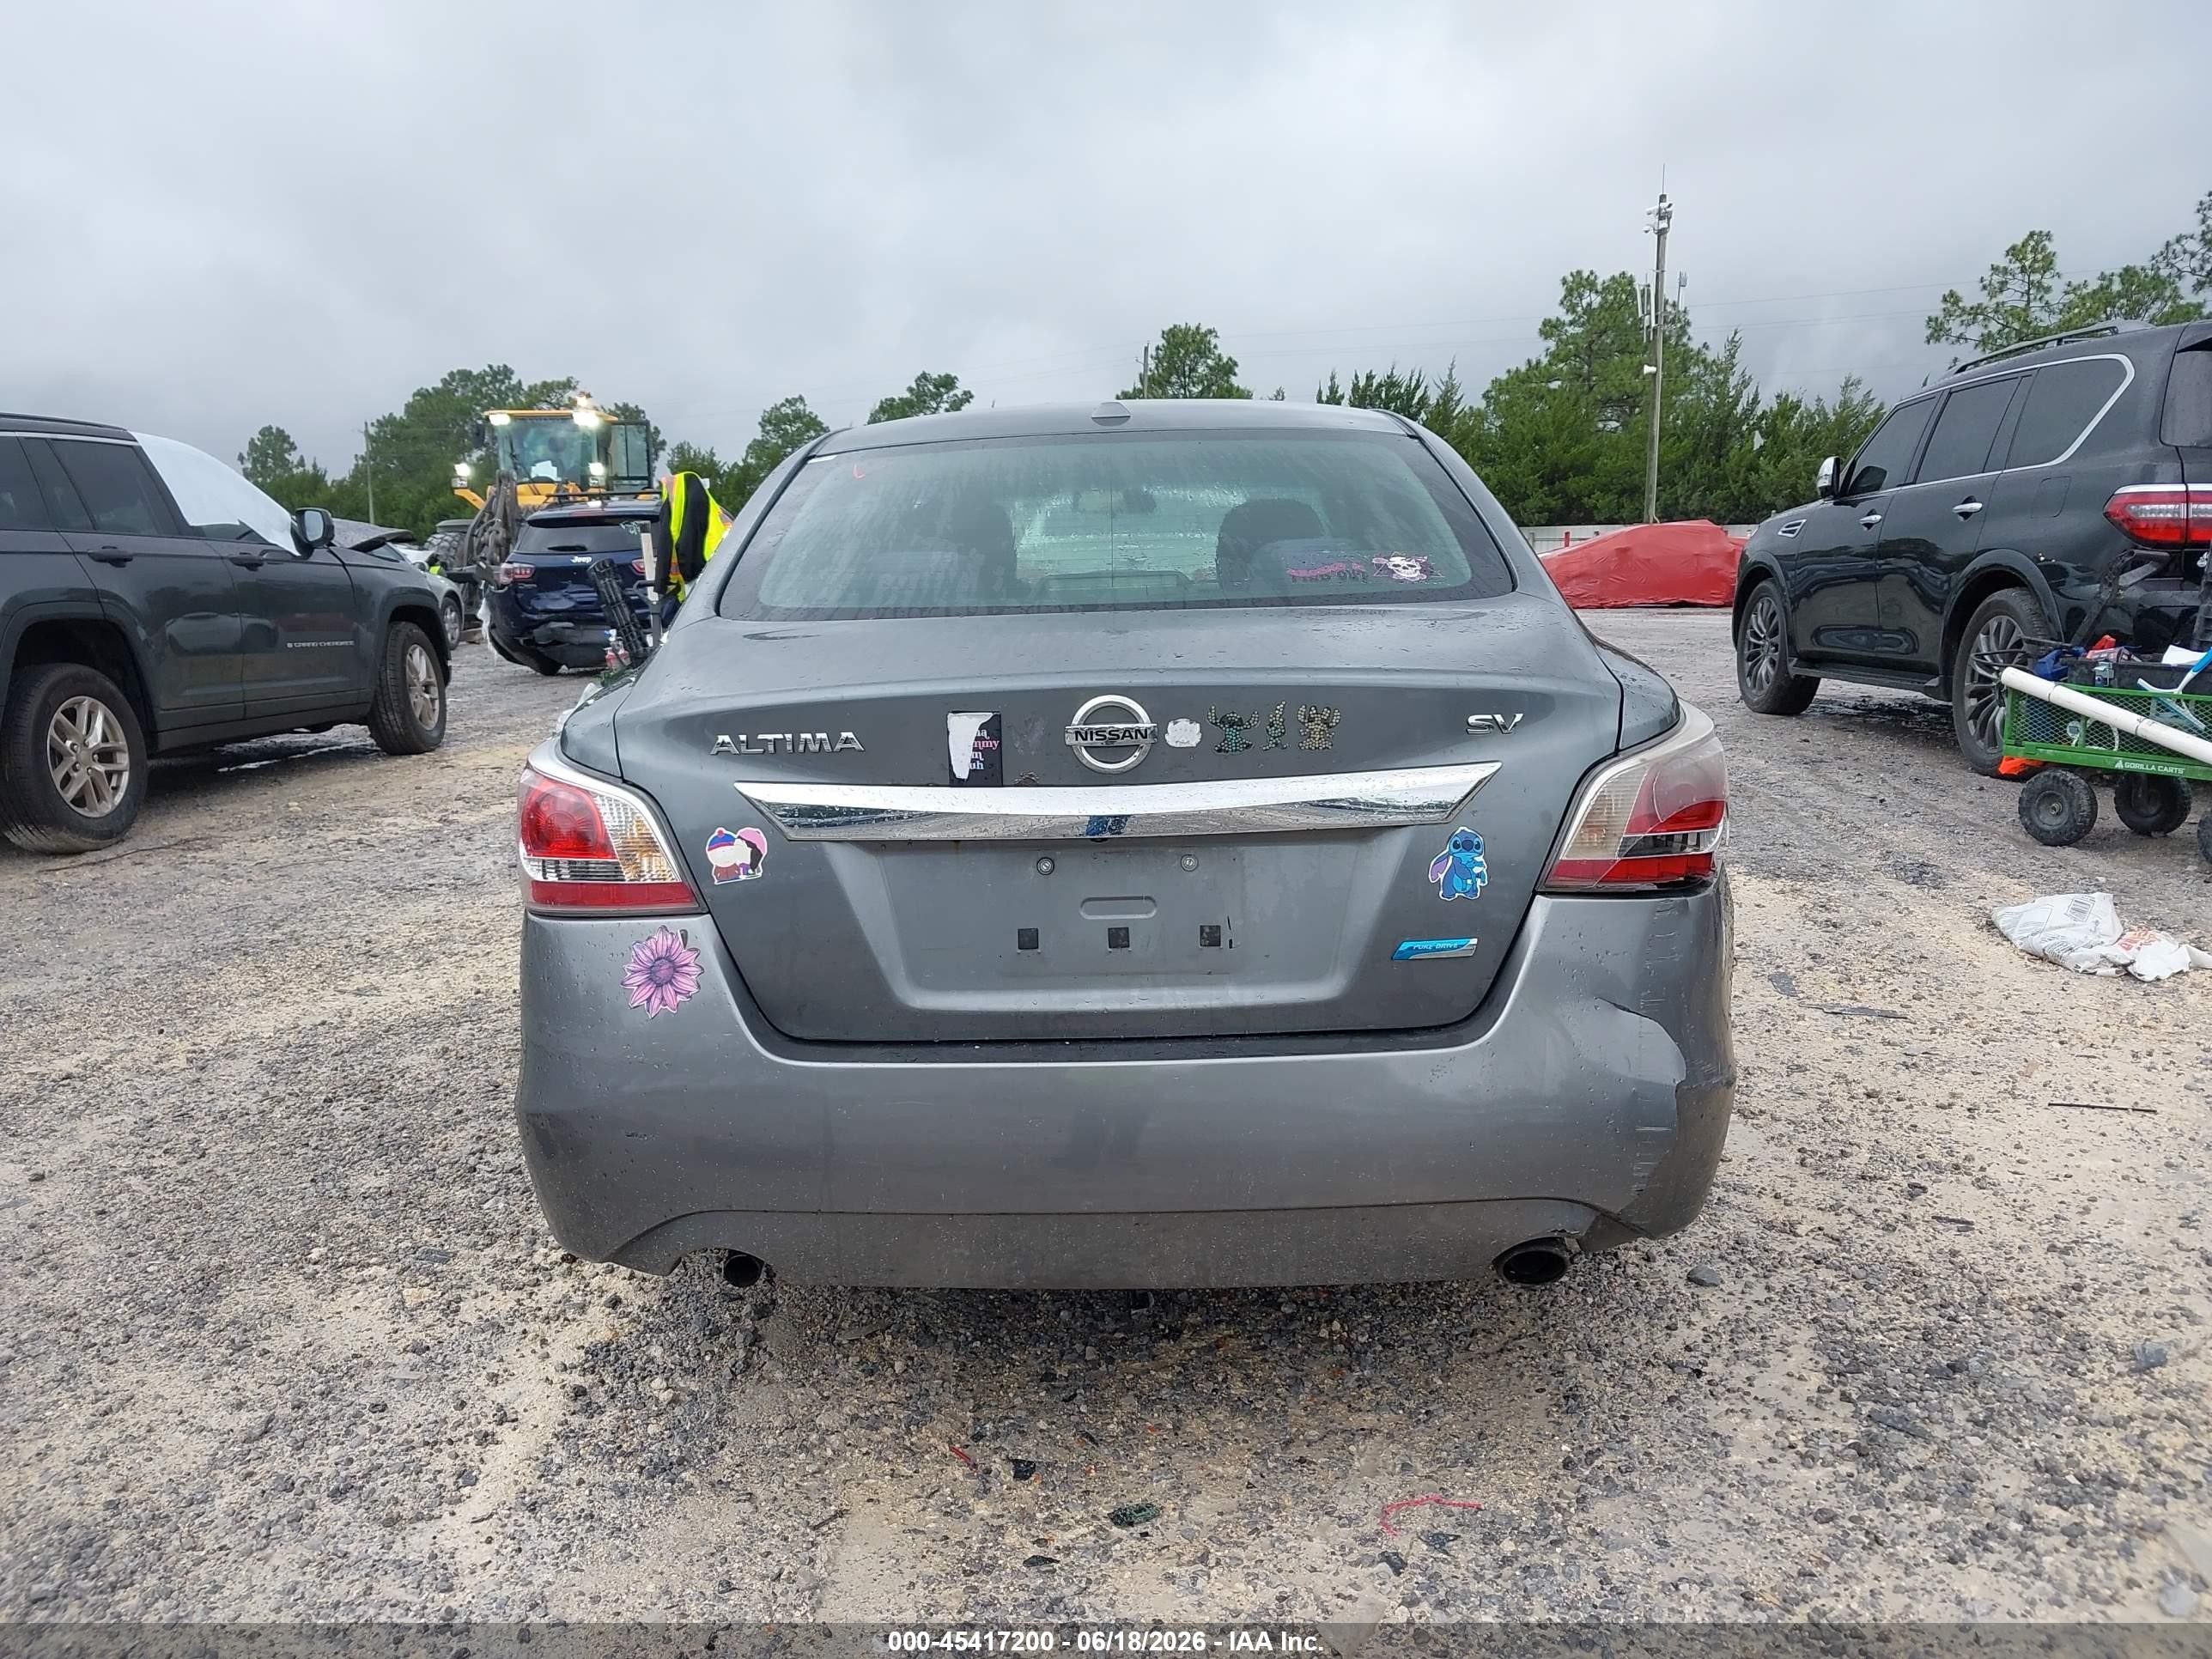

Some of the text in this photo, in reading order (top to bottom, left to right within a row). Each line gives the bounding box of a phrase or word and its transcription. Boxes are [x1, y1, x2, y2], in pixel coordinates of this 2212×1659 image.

[570, 556, 592, 564] Jeep
[1465, 713, 1524, 735] SV
[1074, 728, 1149, 742] NISSAN
[709, 732, 866, 756] ALTIMA
[972, 739, 1000, 750] mmy
[2124, 762, 2185, 775] GORILLA CARTS
